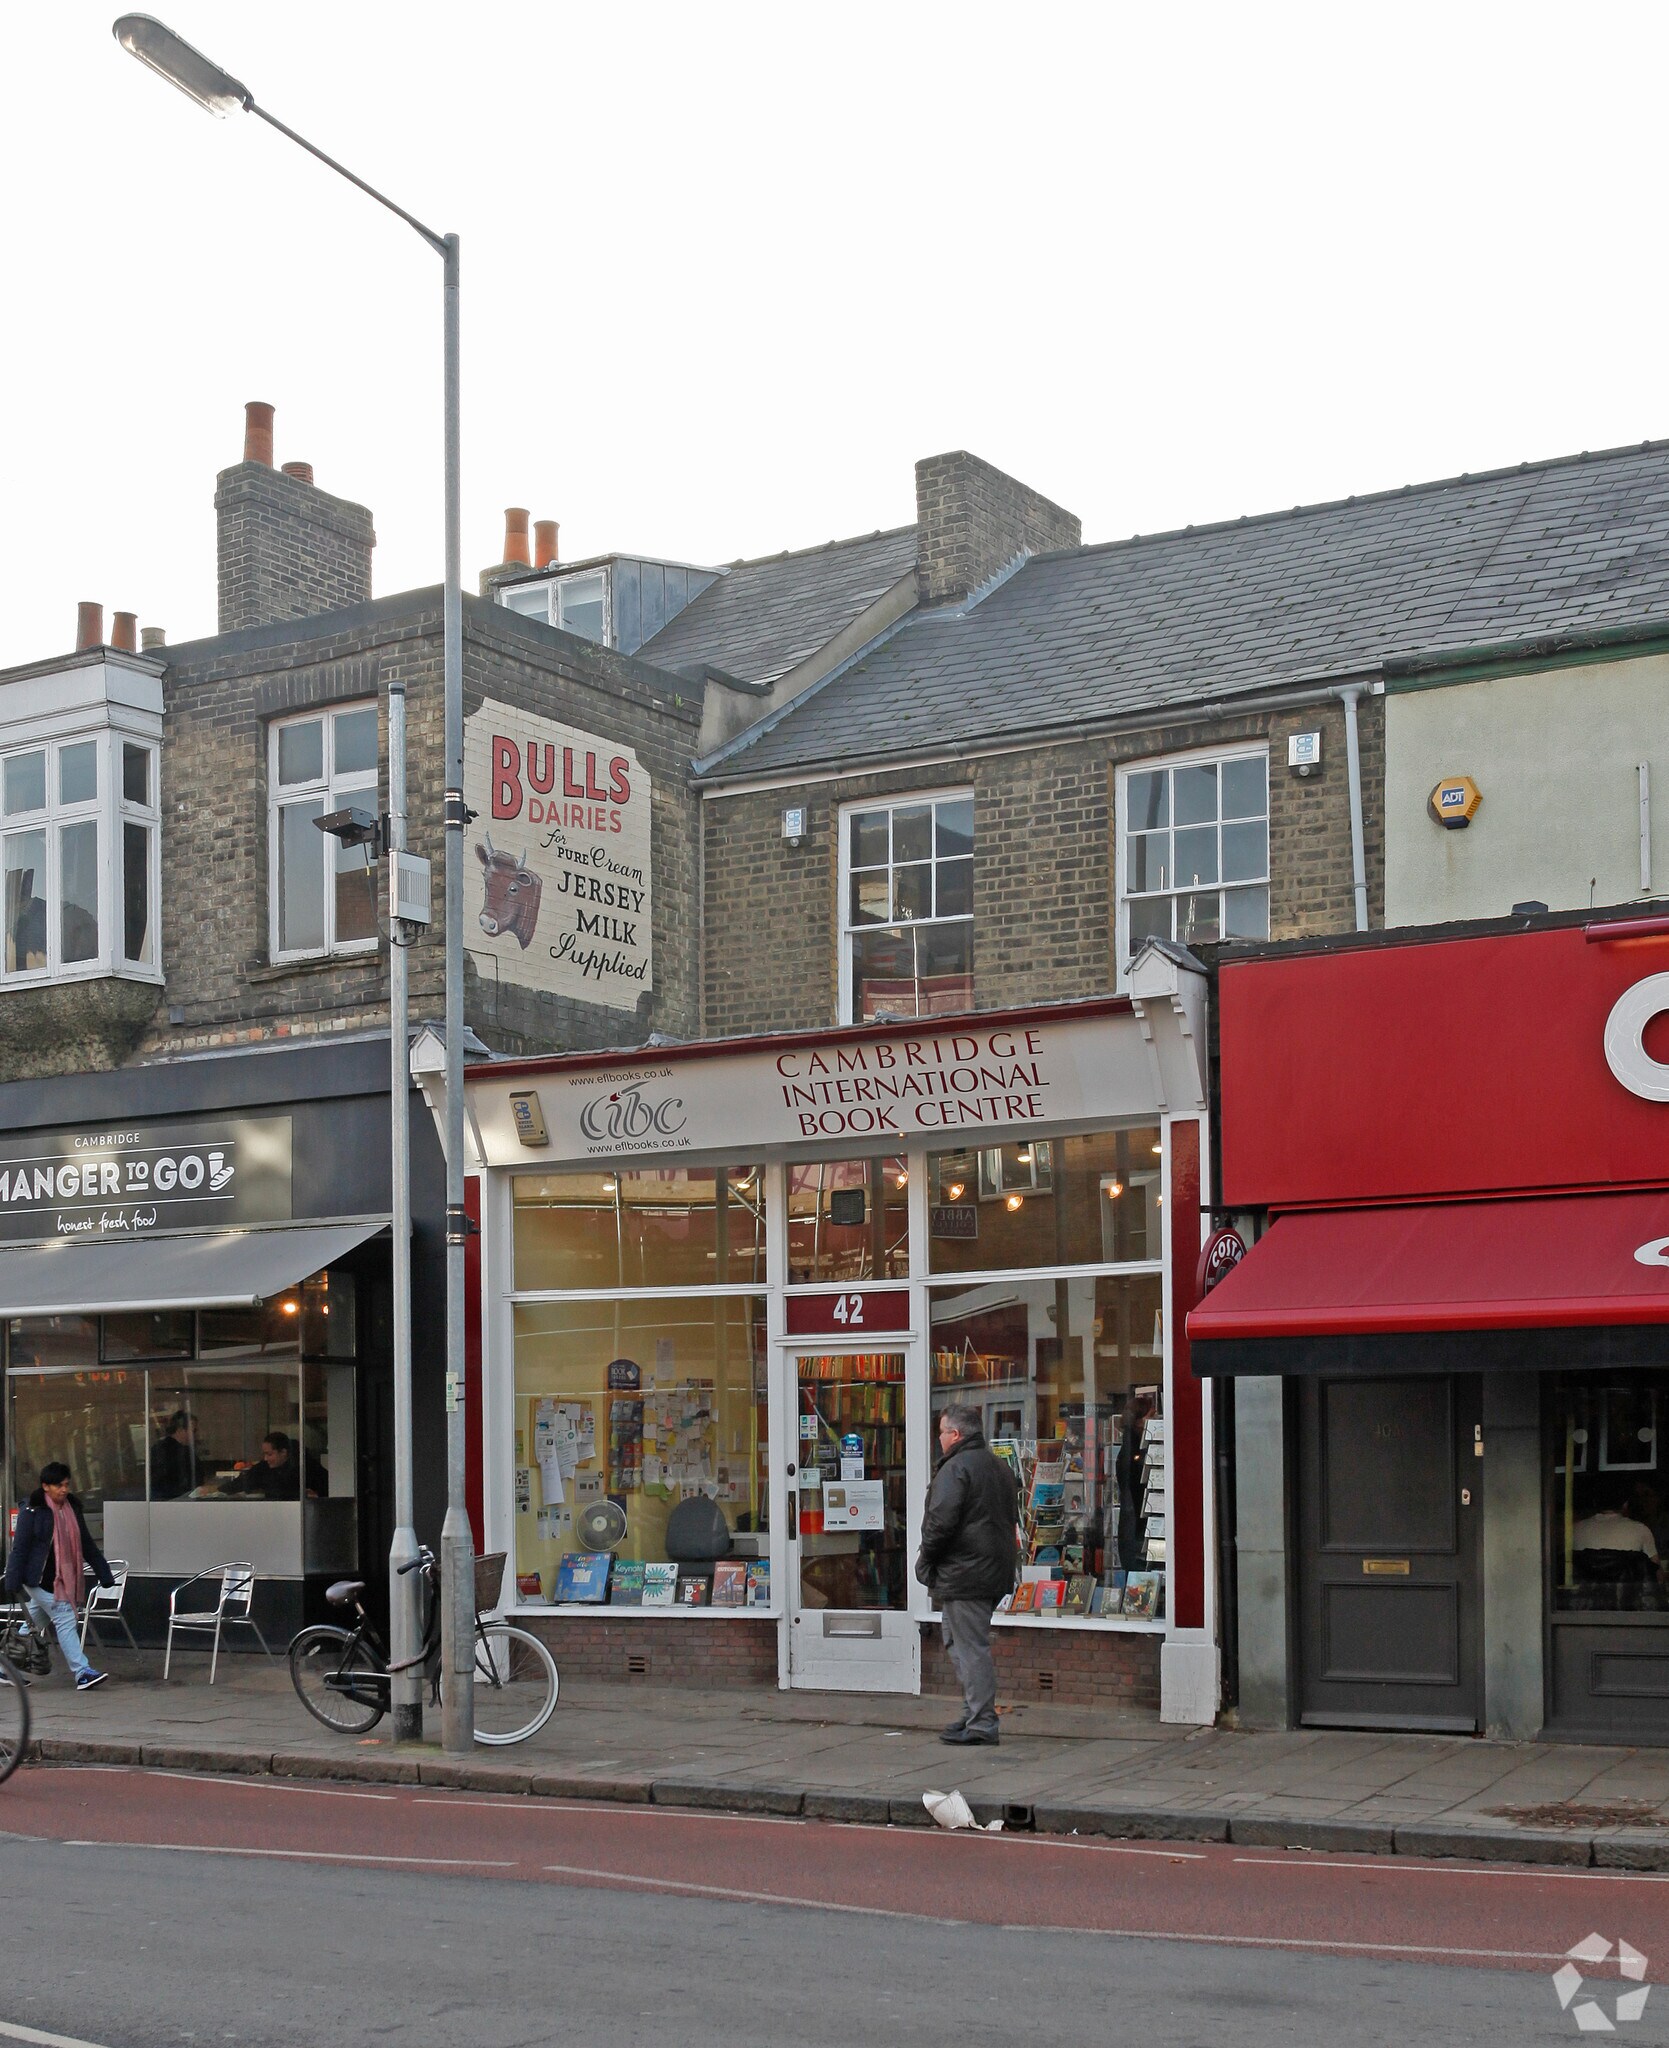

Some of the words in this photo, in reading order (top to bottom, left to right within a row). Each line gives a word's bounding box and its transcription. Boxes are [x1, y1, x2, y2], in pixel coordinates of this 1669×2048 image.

[491, 735, 631, 821] BULLS
[528, 798, 622, 833] DAIRIES
[1442, 791, 1465, 804] ADT
[540, 828, 568, 849] for
[557, 846, 590, 866] PURE
[589, 845, 645, 887] Cream
[557, 871, 646, 914] JERSEY
[576, 909, 637, 946] MILK
[549, 932, 649, 981] Supplied
[776, 1029, 1044, 1079] CAMBRIDGE
[568, 1067, 674, 1087] www.eflbooks.co.uk
[782, 1062, 1051, 1109] INTERNATIONAL
[797, 1105, 895, 1138] BOOK
[915, 1093, 1046, 1126] CENTRE
[74, 1132, 141, 1149] CAMBRIDGE
[586, 1137, 692, 1154] www.eflbooks.co.uk
[126, 1162, 149, 1182] TO
[153, 1154, 206, 1192] GO
[57, 1214, 95, 1234] honest
[98, 1210, 129, 1233] fresh
[131, 1207, 157, 1229] food
[833, 1294, 864, 1324] 42
